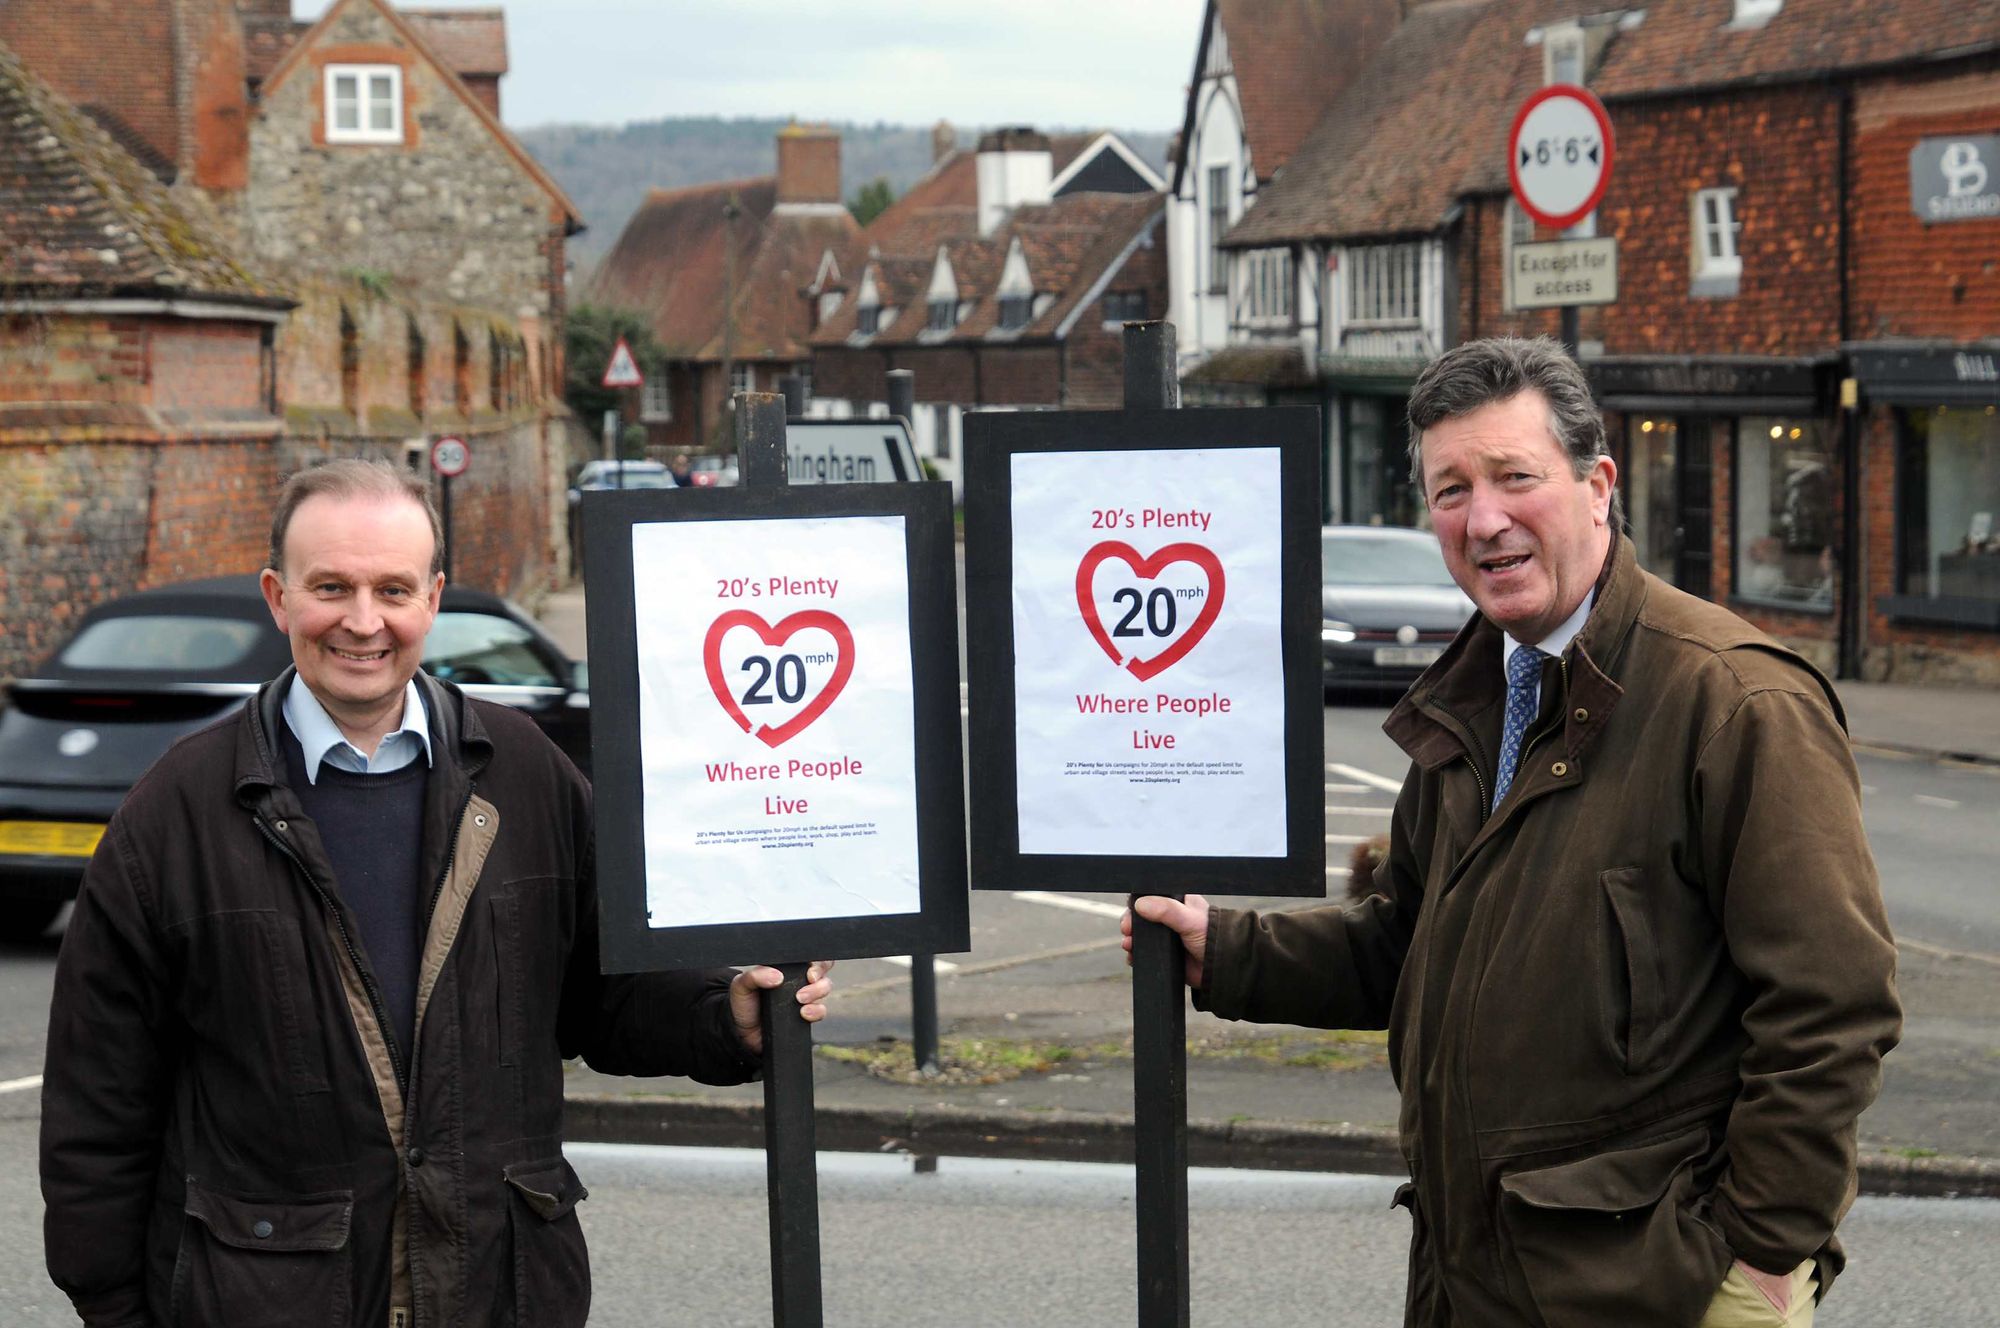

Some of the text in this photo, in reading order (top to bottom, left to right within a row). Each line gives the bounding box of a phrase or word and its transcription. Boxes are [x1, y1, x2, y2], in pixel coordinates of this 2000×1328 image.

[1519, 248, 1608, 274] Except for
[1534, 278, 1593, 297] access
[1091, 508, 1212, 532] 20's Plenty
[717, 576, 839, 599] 20's Plenty
[1112, 586, 1204, 638] 20 mph
[741, 652, 834, 706] 20 mph
[1076, 692, 1231, 718] Where People
[1133, 730, 1176, 749] Live
[705, 755, 863, 783] Where People
[765, 795, 809, 816] Live
[708, 830, 726, 838] Plenty
[744, 828, 772, 836] campaigns
[839, 823, 854, 831] speed
